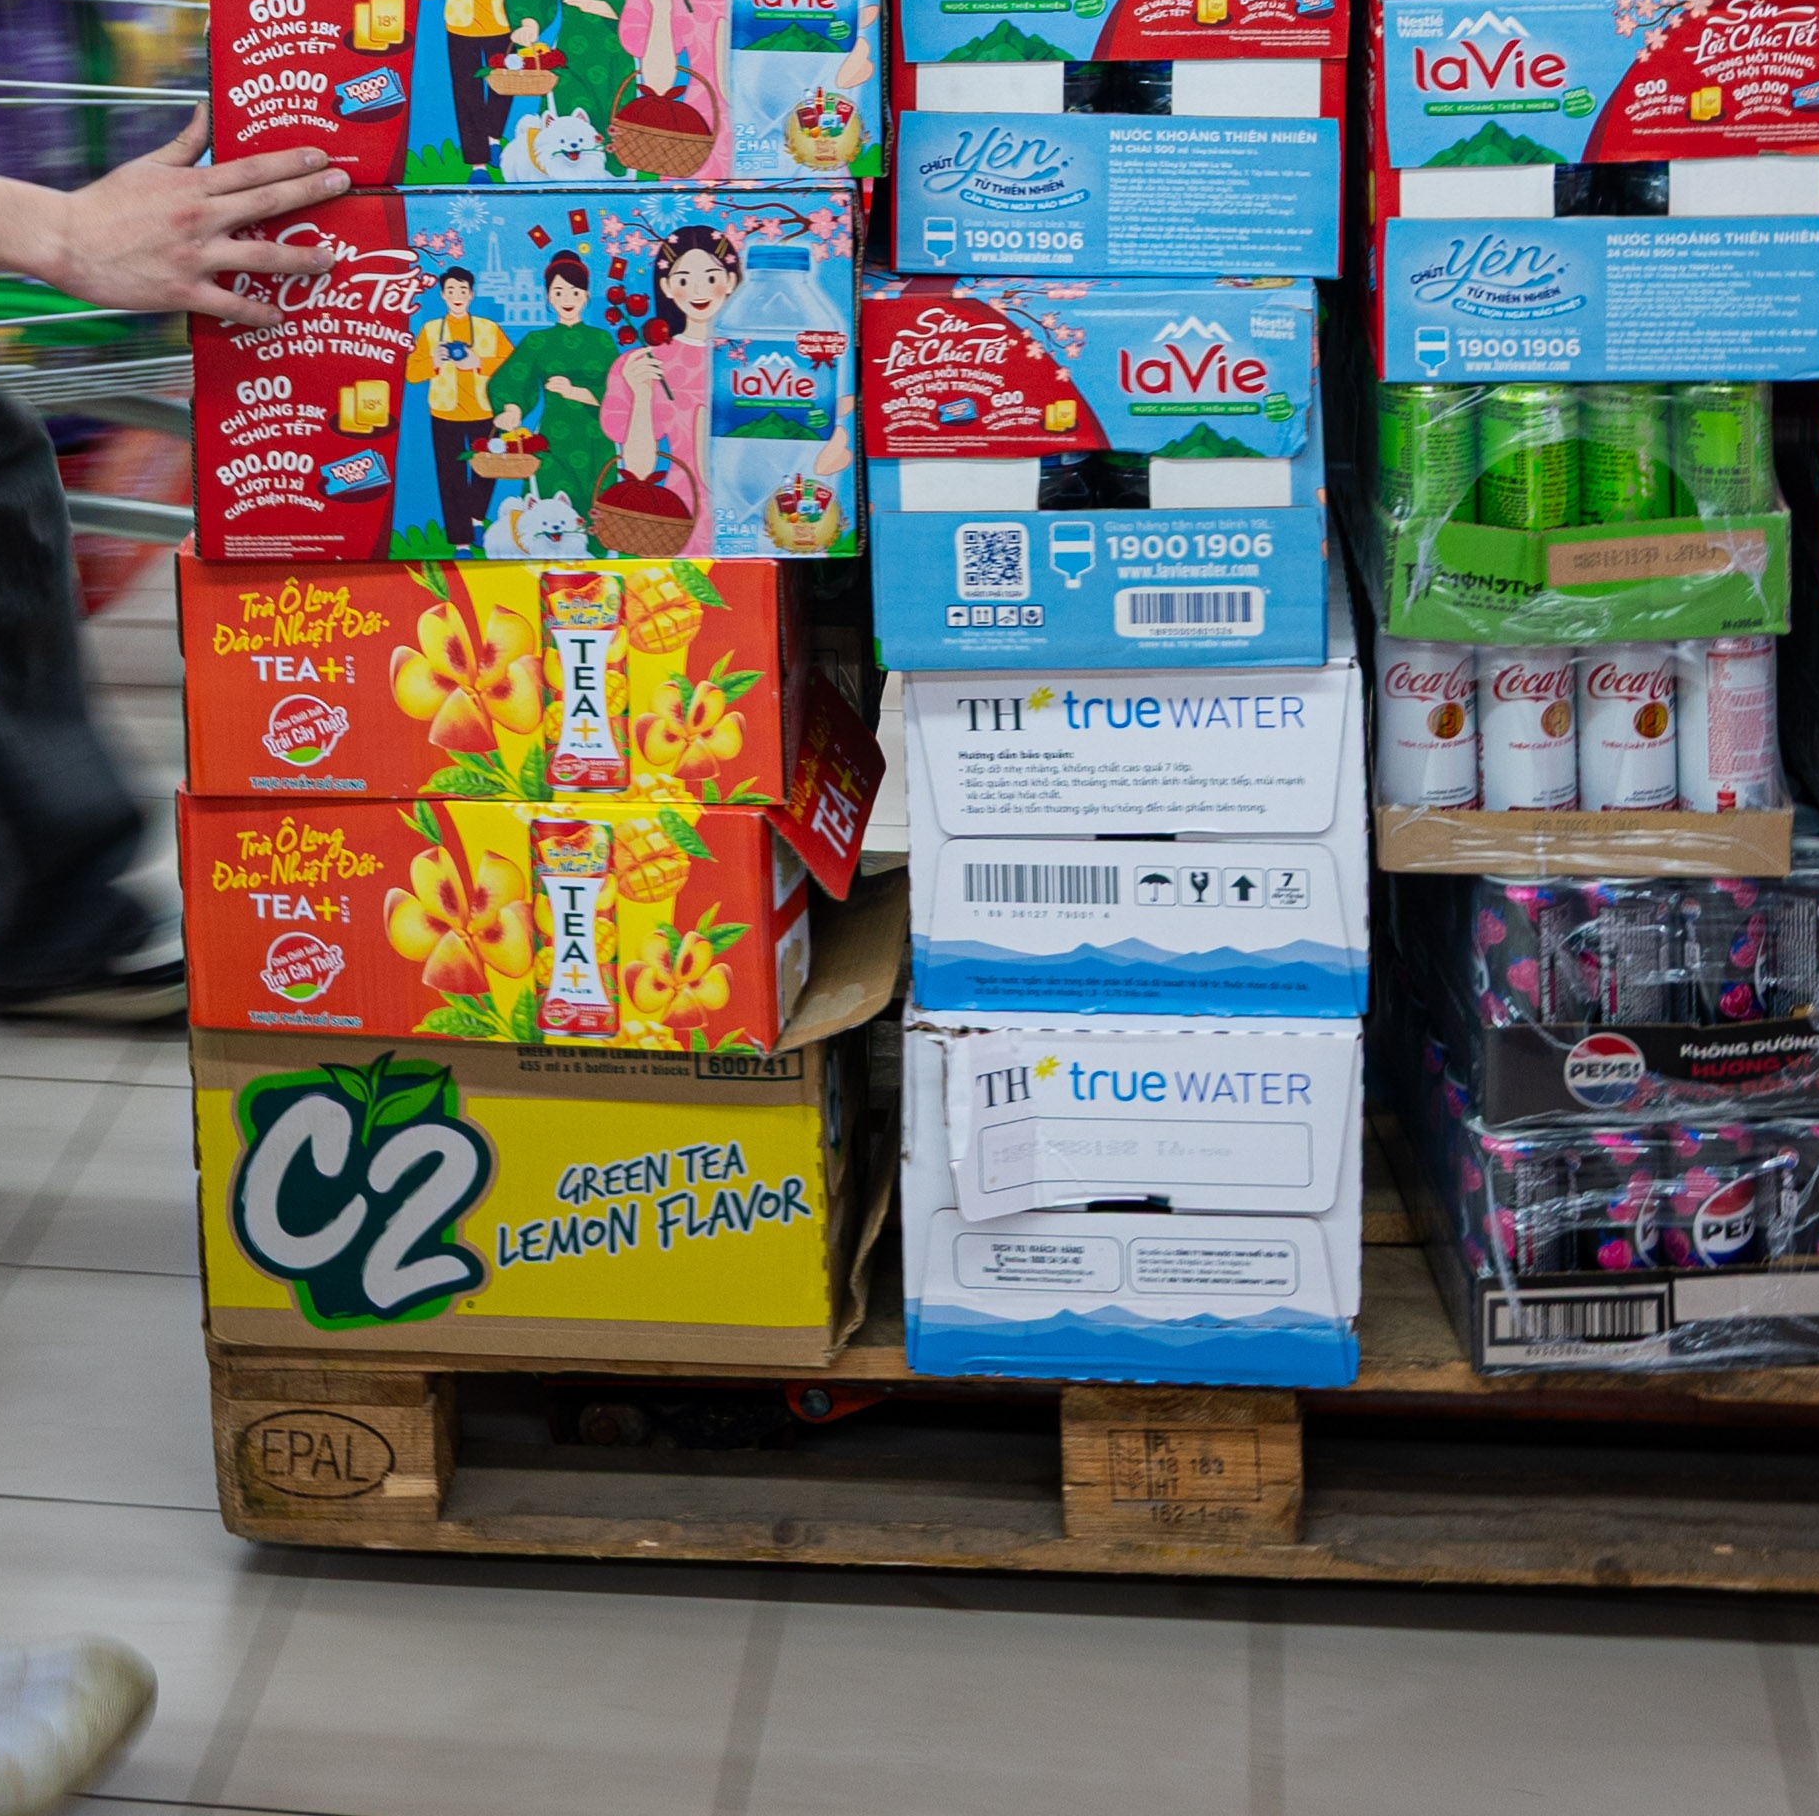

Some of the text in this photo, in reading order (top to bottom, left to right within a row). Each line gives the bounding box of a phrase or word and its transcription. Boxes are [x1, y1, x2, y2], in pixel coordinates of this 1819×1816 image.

[232, 21, 341, 56] CHỈ VÀNG 18K
[227, 70, 328, 108] 800.000
[963, 230, 1084, 251] 1900 1906
[238, 576, 349, 622] Trà Ô Long
[957, 690, 1305, 732] TH true WATER
[708, 1056, 789, 1076] 600741
[1568, 1058, 1641, 1080] PEPSI
[557, 1142, 746, 1204] GREEN TEA
[240, 1094, 478, 1310] C2
[498, 1178, 810, 1266] LEMON FLAVOR
[261, 1428, 370, 1483] EPAL
